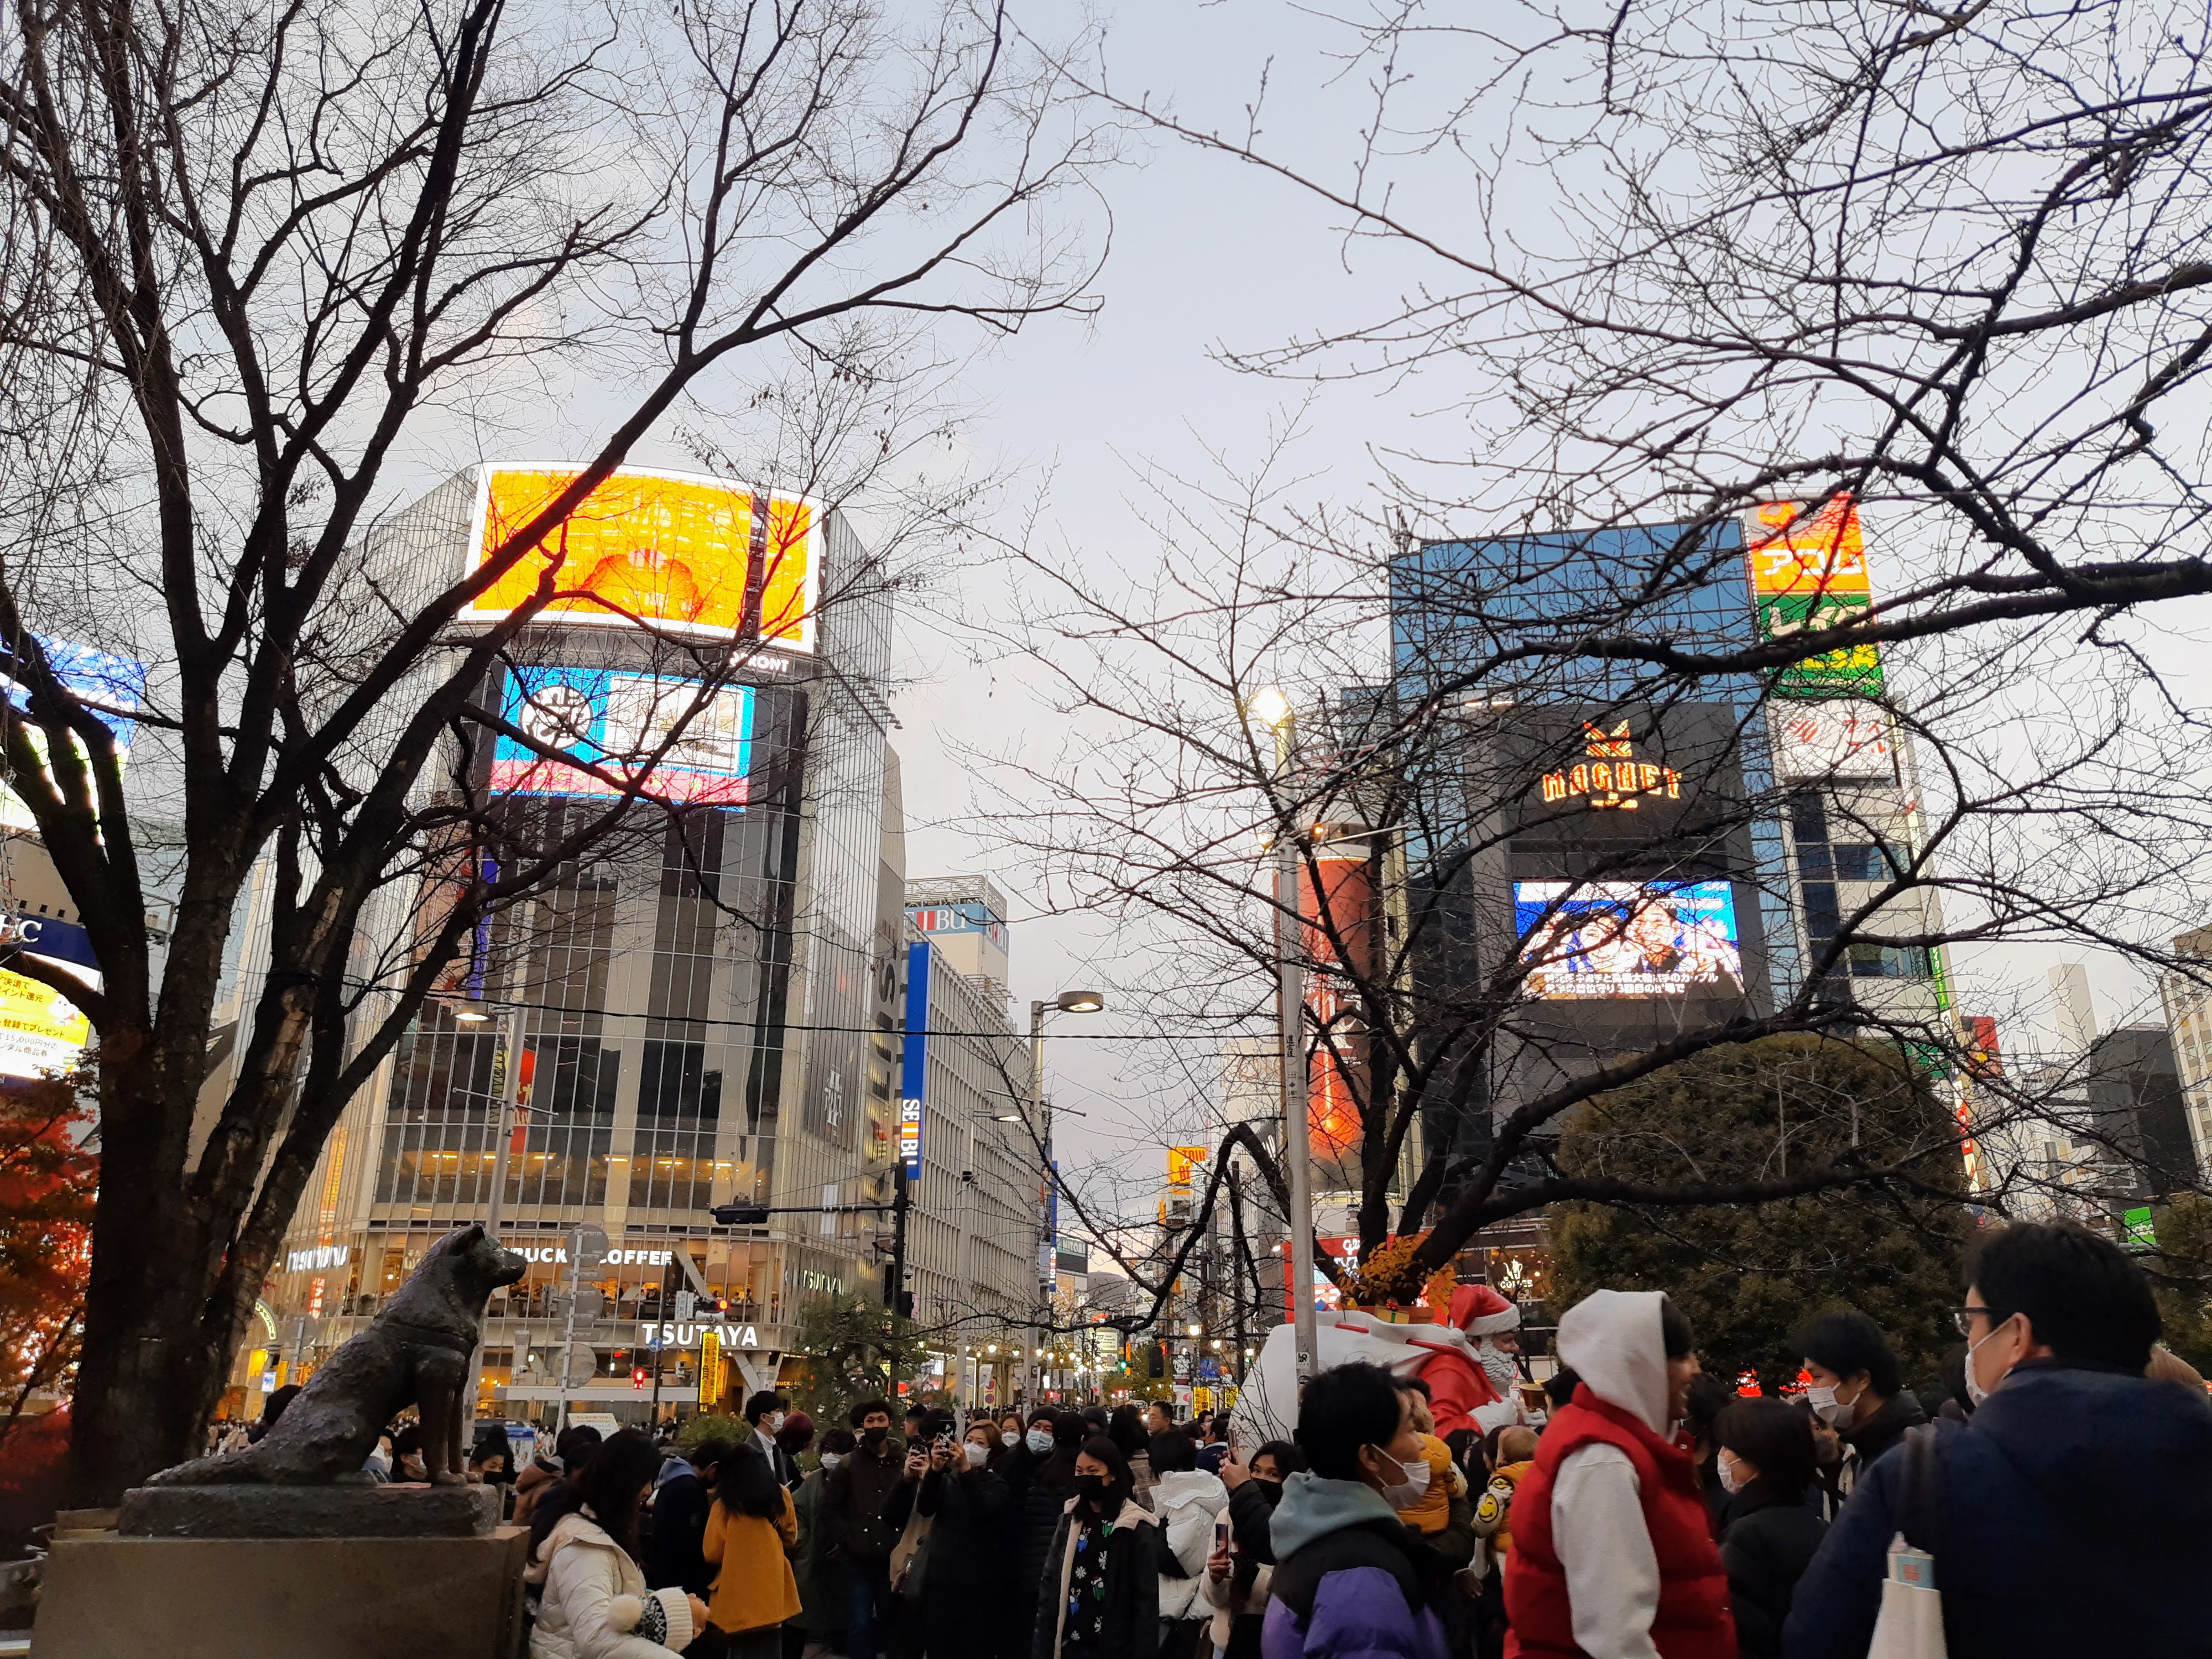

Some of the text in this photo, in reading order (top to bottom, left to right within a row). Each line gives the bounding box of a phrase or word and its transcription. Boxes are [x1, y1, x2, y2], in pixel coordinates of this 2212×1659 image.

[1762, 549, 1863, 576] アコム
[1543, 762, 1682, 802] MAGNET
[0, 986, 44, 1003] イント還元
[1062, 1239, 1086, 1254] NITORI
[599, 1249, 673, 1266] OFFEE
[641, 1323, 758, 1347] TSUTAYA
